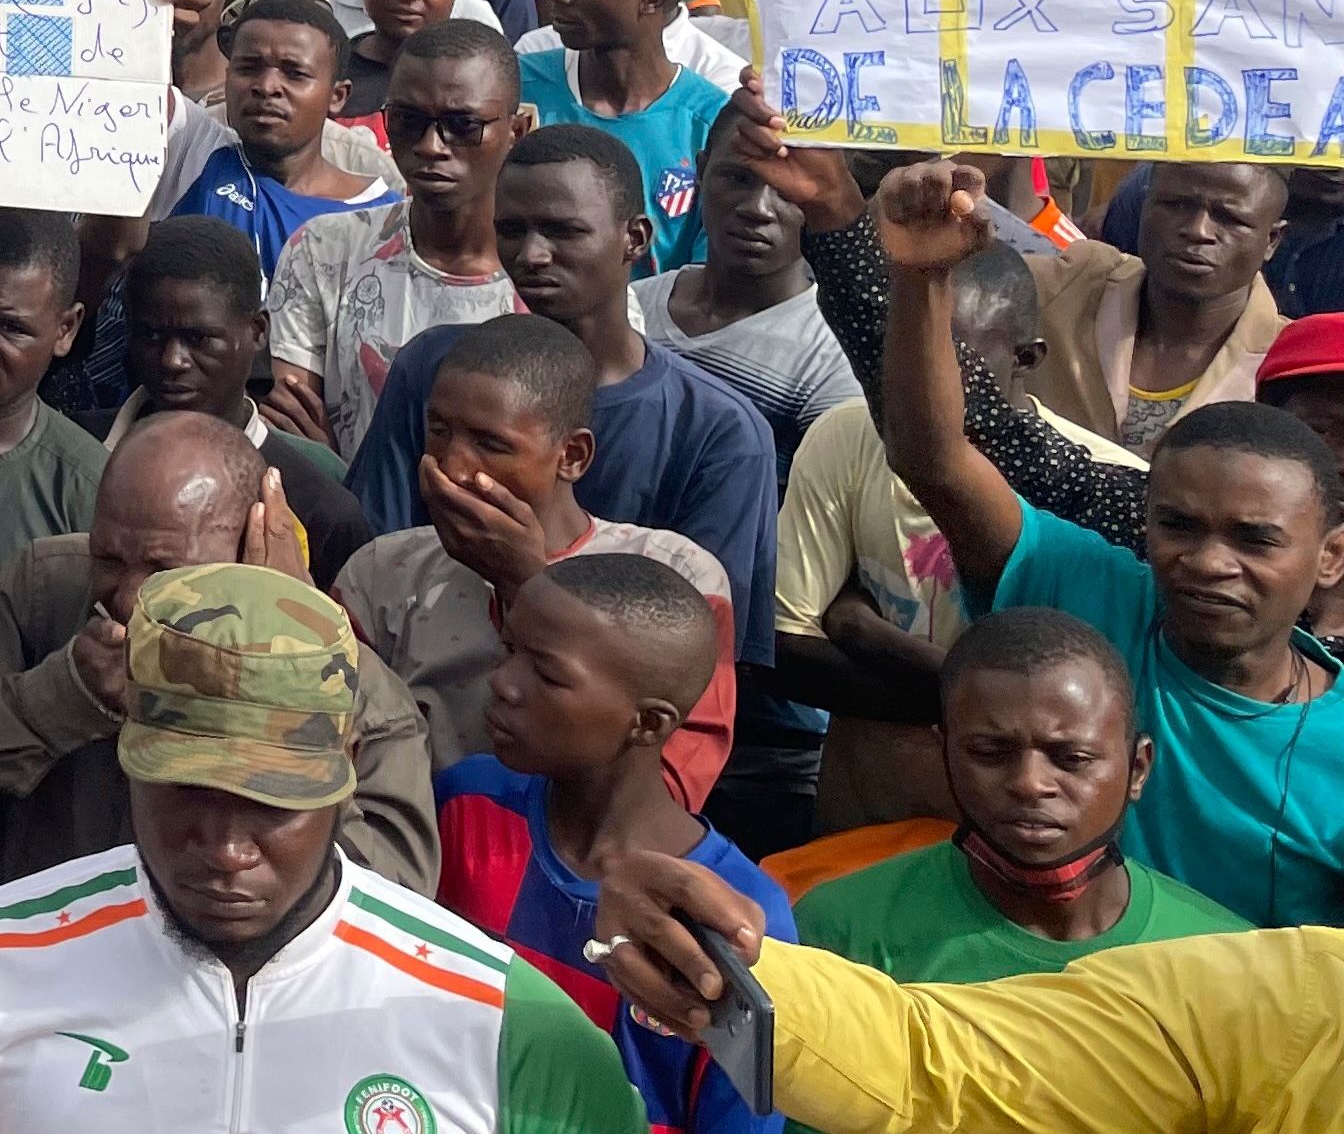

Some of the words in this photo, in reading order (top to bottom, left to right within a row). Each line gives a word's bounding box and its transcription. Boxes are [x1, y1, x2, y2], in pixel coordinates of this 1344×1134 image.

[80, 23, 125, 66] de
[781, 48, 899, 144] DE
[355, 1082, 421, 1105] FENIFOOT
